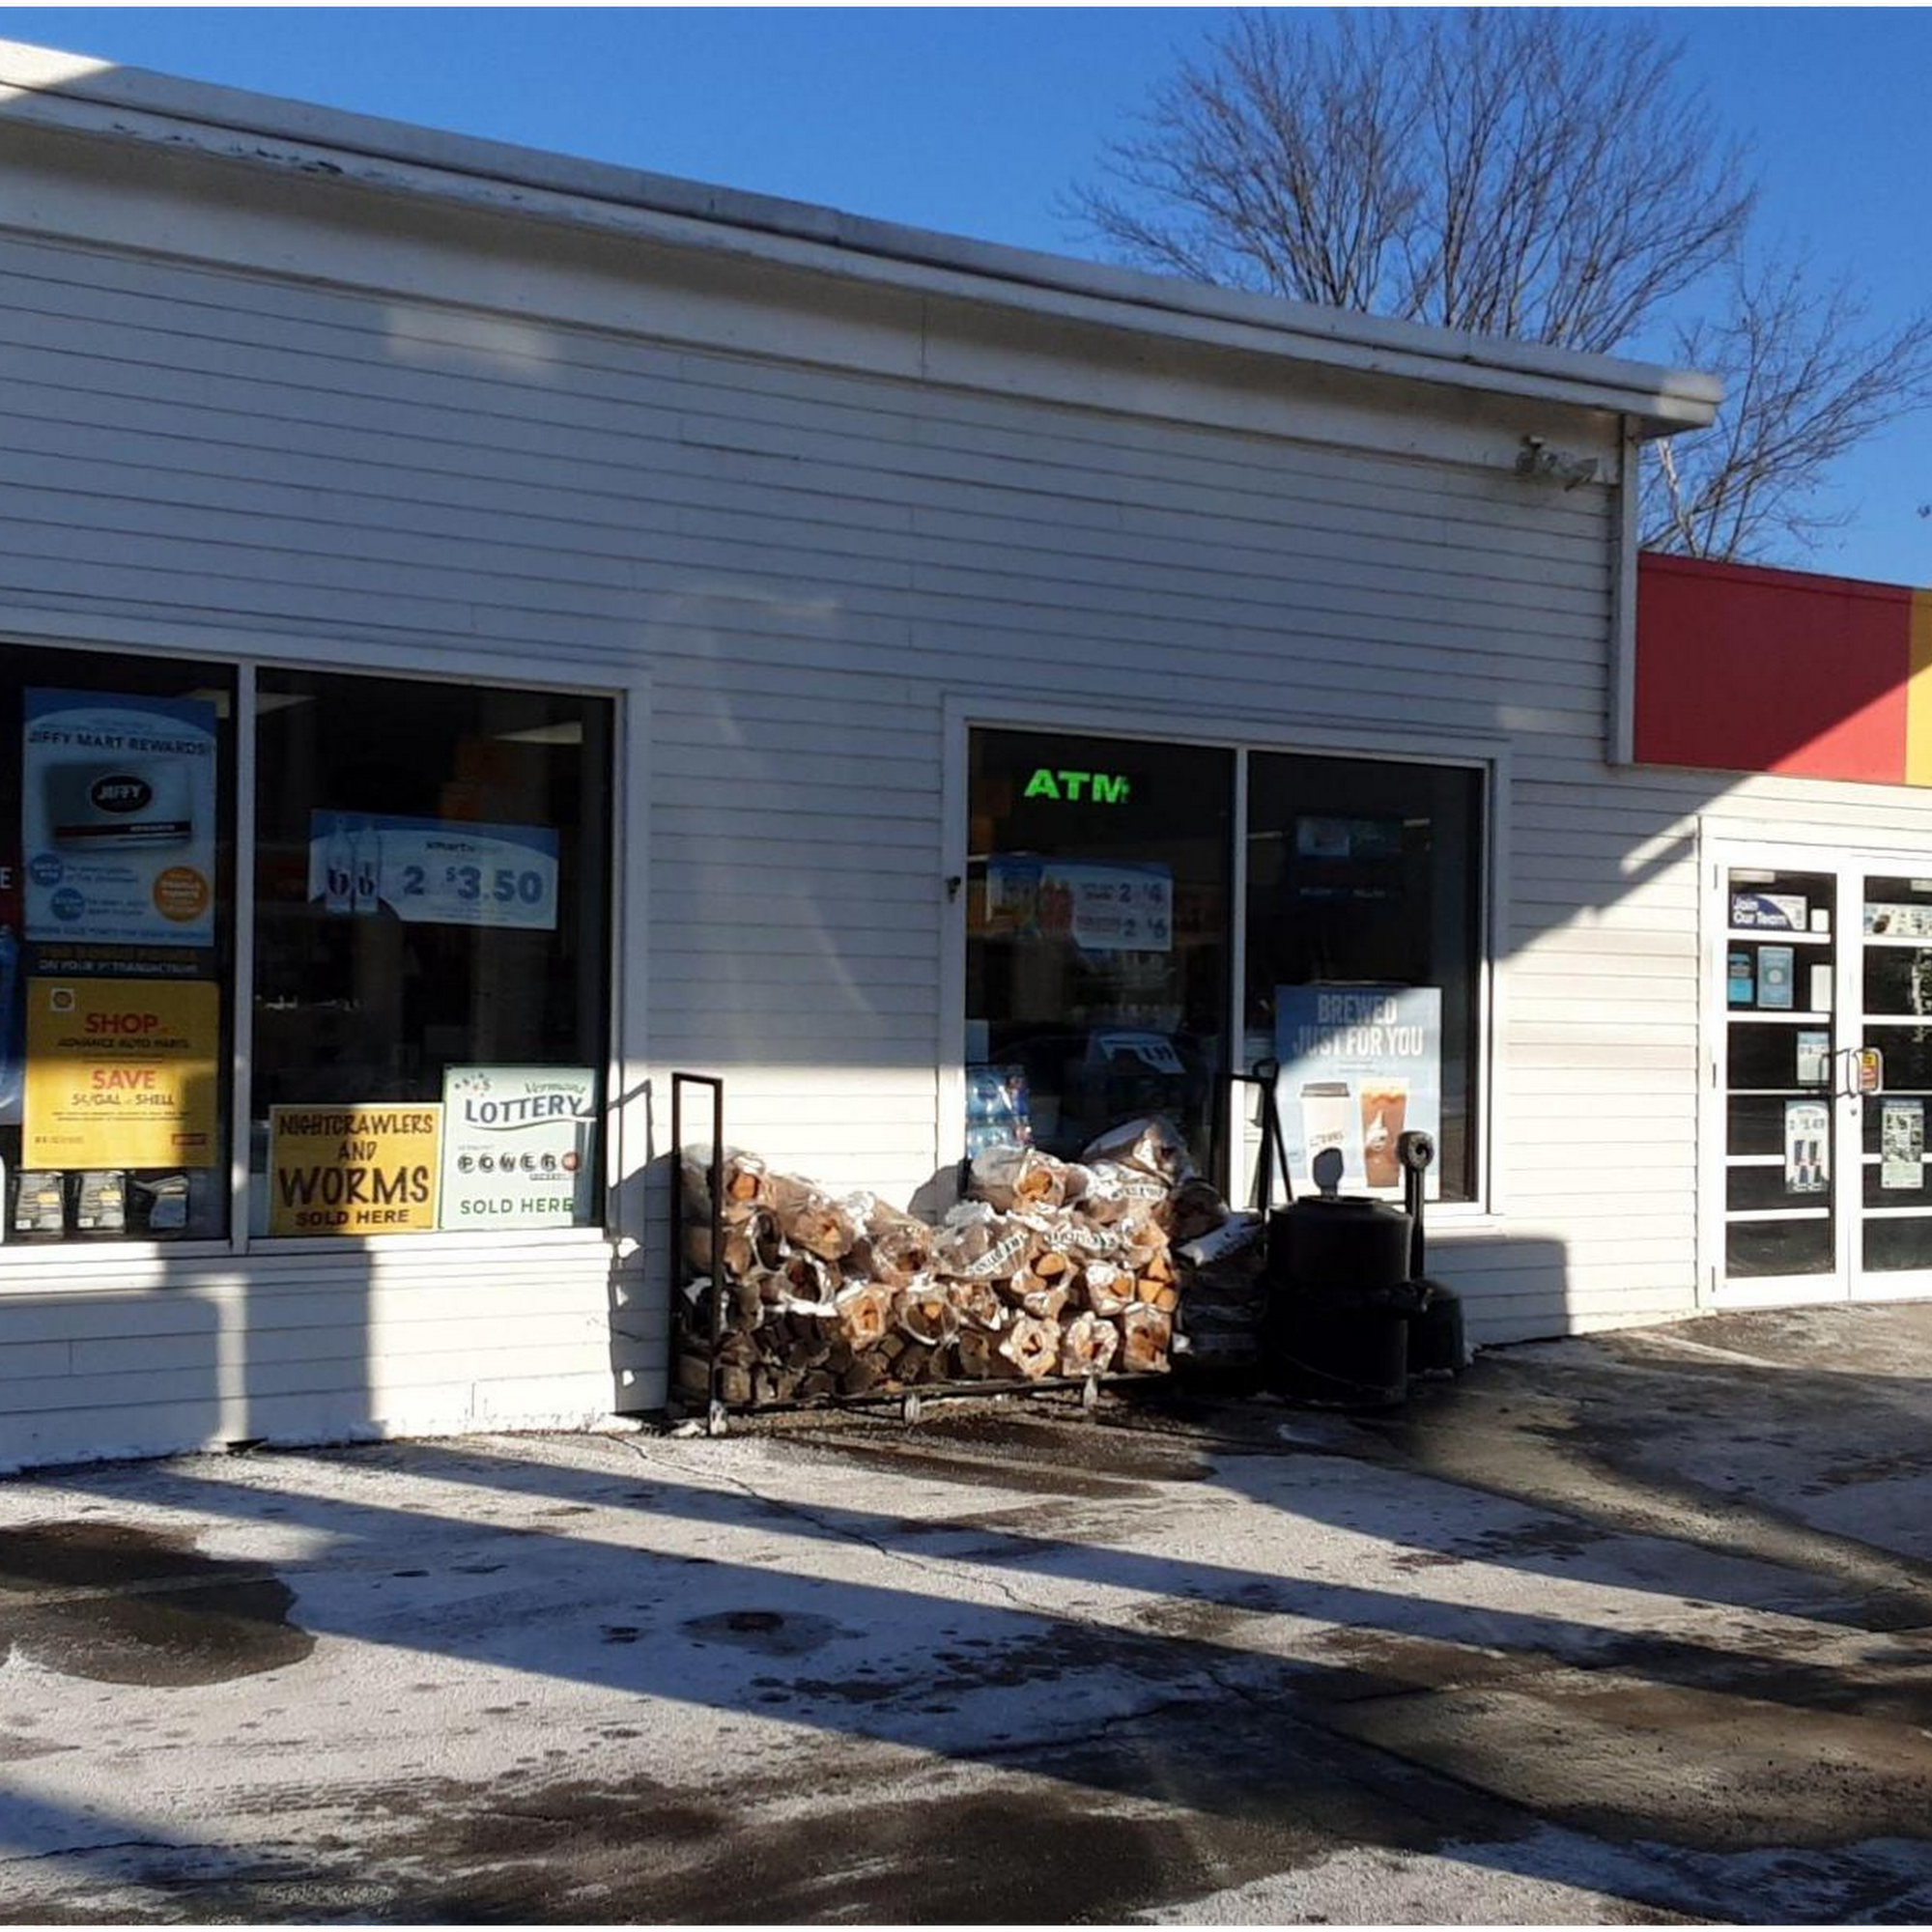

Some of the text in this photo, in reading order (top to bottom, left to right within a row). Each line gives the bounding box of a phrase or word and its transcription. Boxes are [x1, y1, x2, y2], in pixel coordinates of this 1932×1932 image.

[29, 729, 70, 745] JIFFY
[75, 733, 125, 749] MART
[98, 784, 143, 801] JIFFY
[1024, 769, 1130, 804] ATM
[403, 865, 426, 896] 2
[1119, 882, 1132, 904] 2
[1123, 918, 1138, 938] 2
[1318, 995, 1398, 1025] BREWED
[84, 1012, 159, 1035] SHOP
[1293, 1026, 1424, 1056] JUST FOR YOU
[92, 1068, 156, 1091] SAVE
[135, 1094, 175, 1106] SHELL
[466, 1094, 582, 1124] LOTTERY
[278, 1114, 434, 1136] NIGHTCRAWLERS
[338, 1139, 378, 1161] AND
[278, 1165, 430, 1208] WORMS
[460, 1197, 575, 1215] SOLD HERE
[295, 1208, 411, 1227] SOLD HERE
